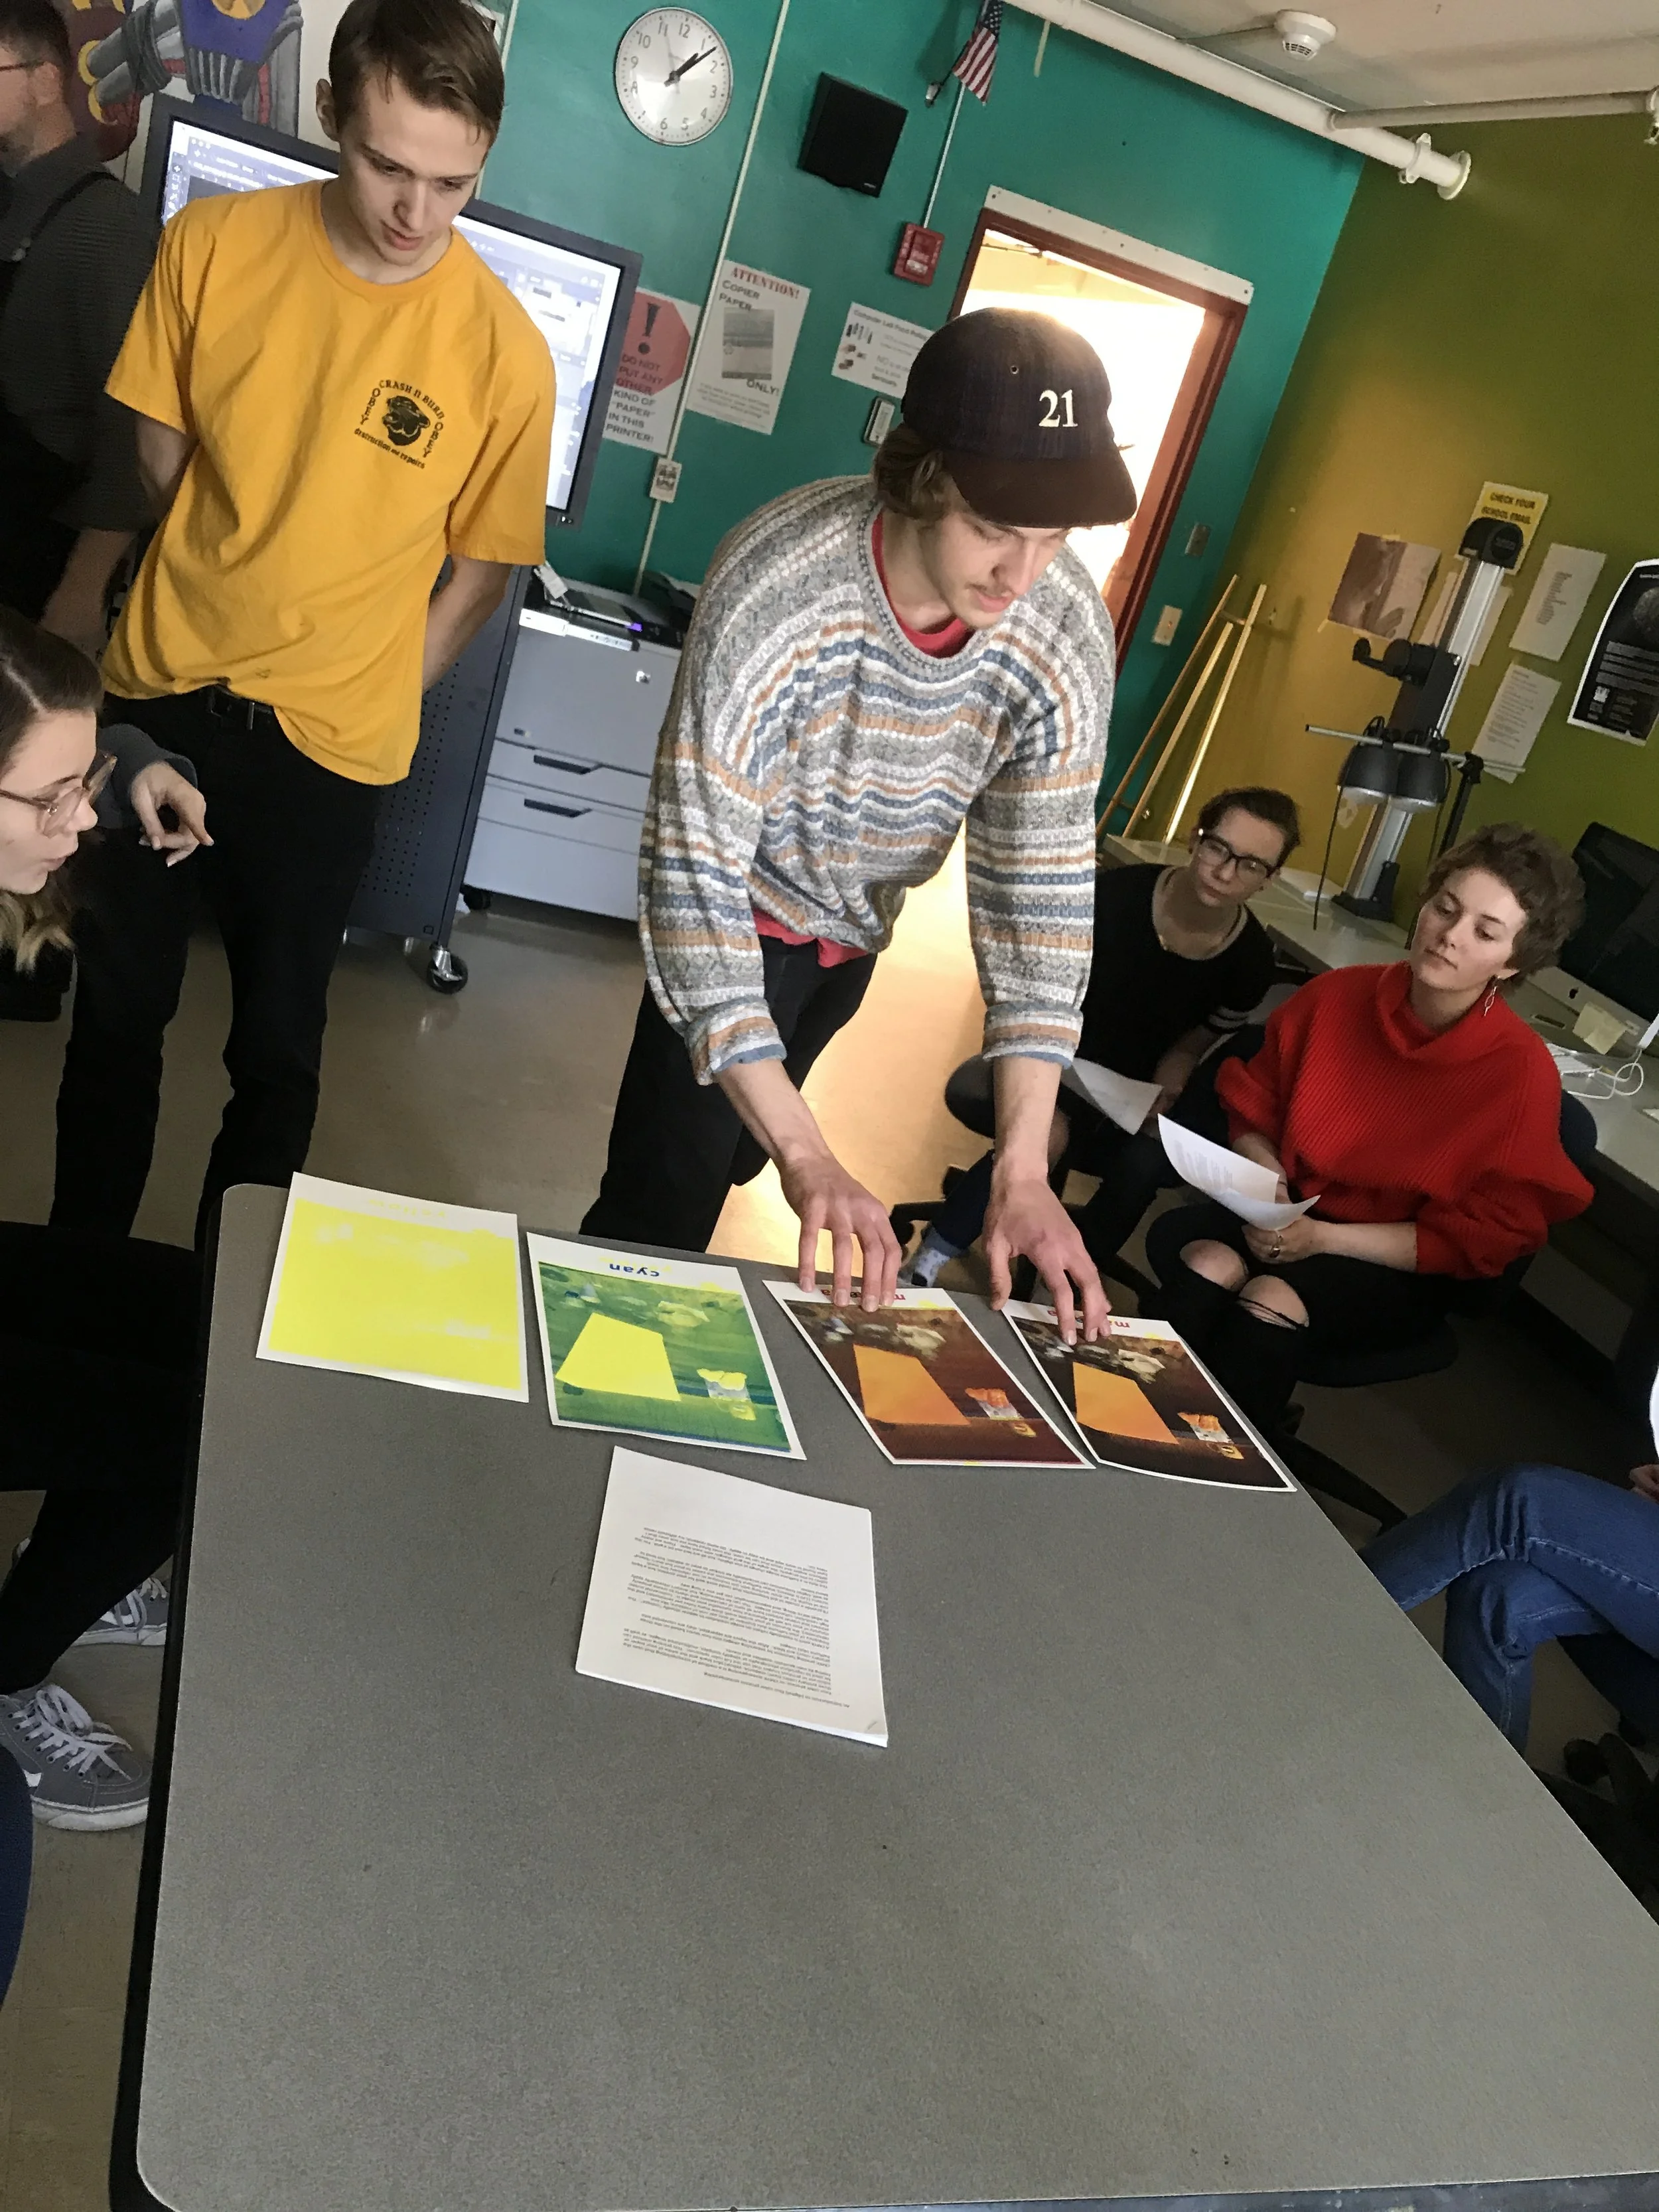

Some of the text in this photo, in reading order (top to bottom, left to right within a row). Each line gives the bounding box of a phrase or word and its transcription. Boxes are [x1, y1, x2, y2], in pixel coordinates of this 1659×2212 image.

[658, 21, 669, 37] 11
[678, 23, 691, 38] 12
[636, 32, 651, 48] 10
[631, 56, 638, 68] 9
[709, 60, 717, 74] 2
[709, 85, 717, 98] 3
[701, 107, 707, 119] 4
[660, 117, 668, 130] 6
[721, 279, 760, 300] COPIER
[731, 267, 800, 299] ATTENTION!
[719, 292, 752, 311] PAPER
[622, 354, 662, 372] DO NOT
[618, 366, 664, 385] PUT ANY
[379, 380, 412, 394] CRASH
[615, 378, 654, 396] OTHER
[747, 379, 780, 396] ONLY!
[360, 388, 381, 425] OBEY
[613, 390, 657, 407] KIND OF
[1039, 389, 1078, 427] 21
[608, 412, 645, 429] IN THIS
[354, 428, 391, 451] destruction
[423, 421, 444, 459] OBEY
[609, 1264, 660, 1278] cyan
